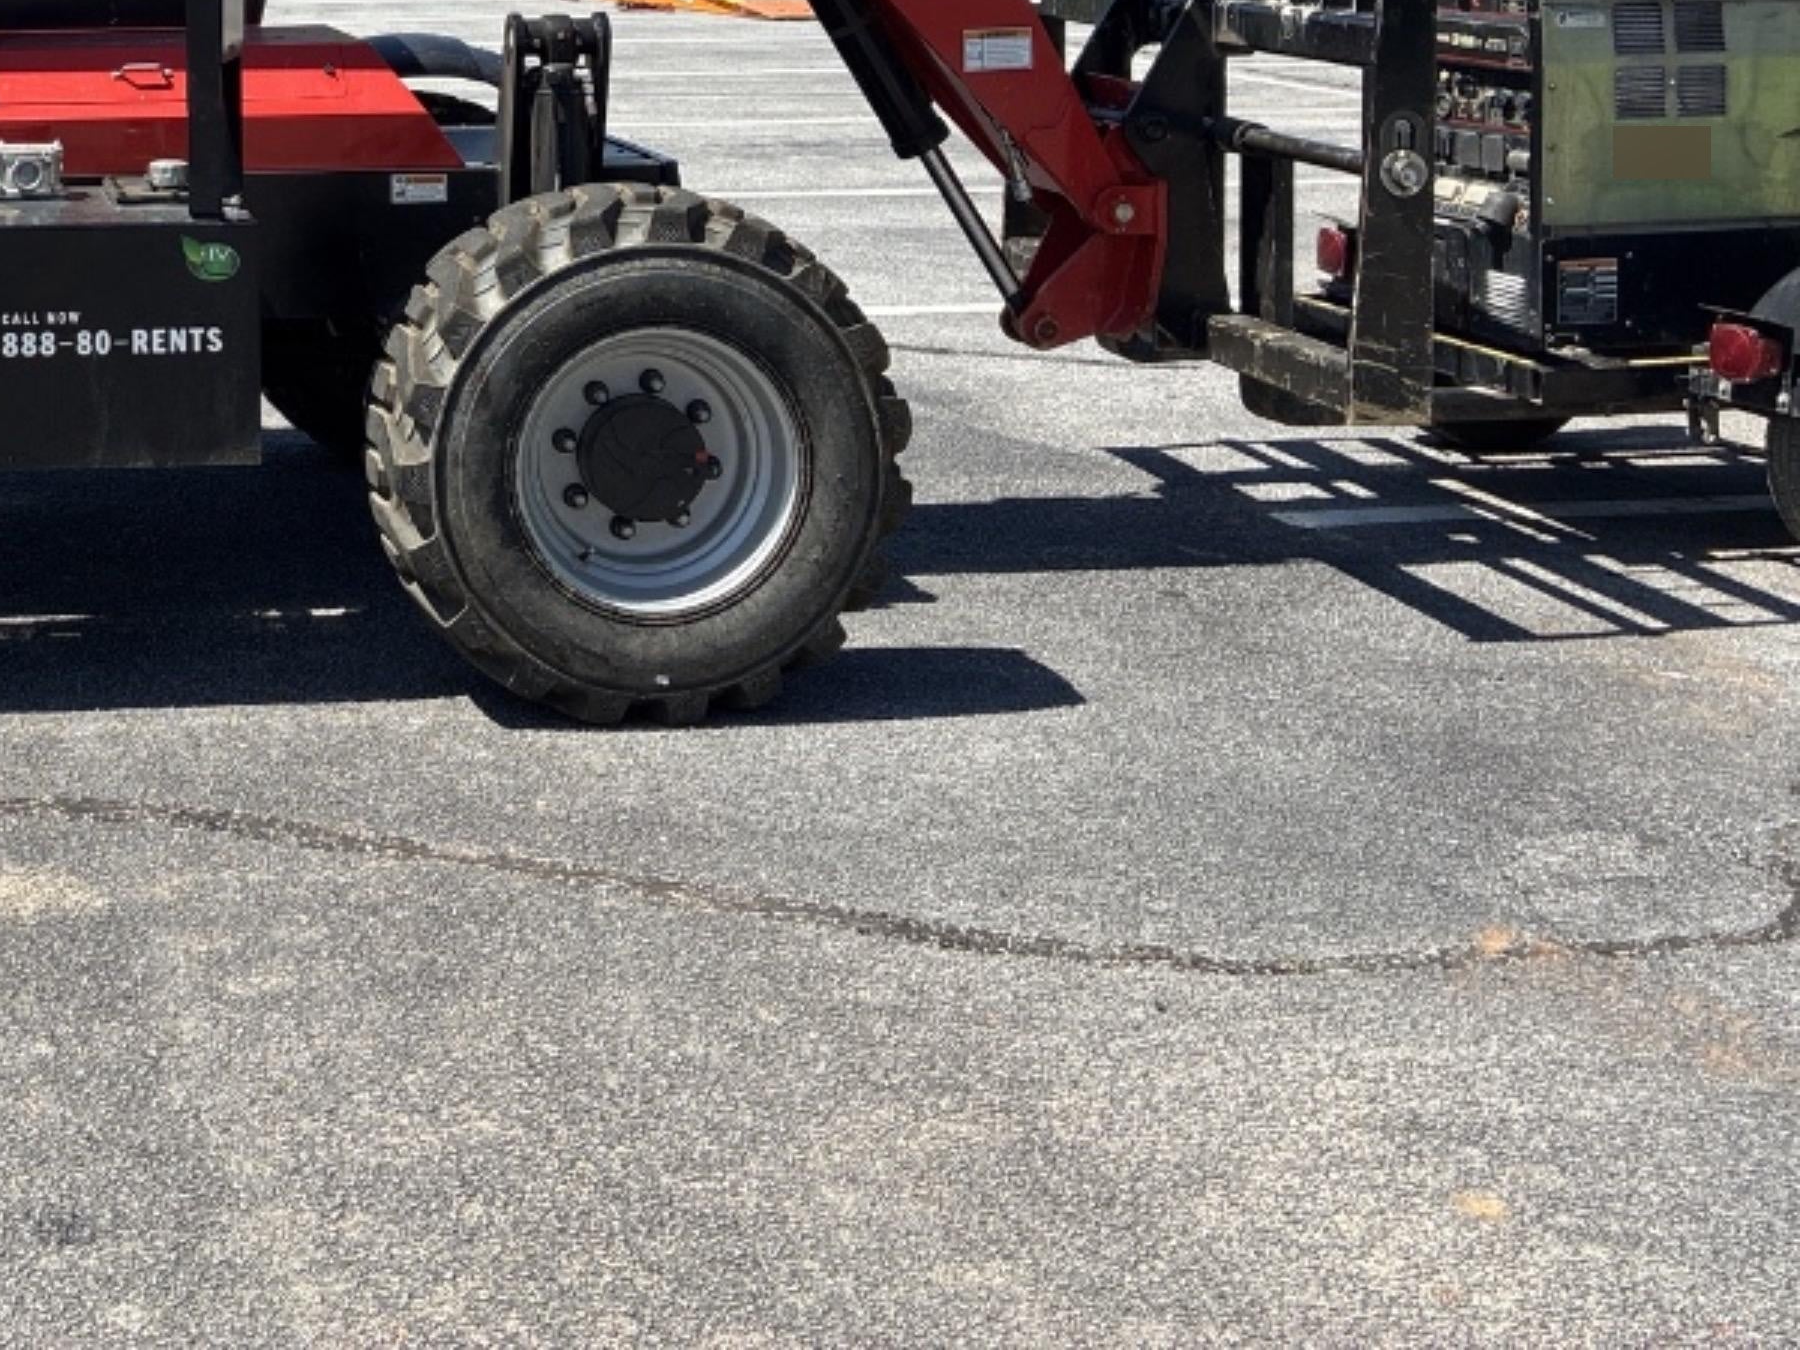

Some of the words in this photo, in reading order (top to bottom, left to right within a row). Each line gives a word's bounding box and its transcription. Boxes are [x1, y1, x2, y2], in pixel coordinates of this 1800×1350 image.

[2, 311, 40, 326] CALL
[47, 310, 82, 325] NOW
[1, 326, 224, 358] 888-80-RENTS
